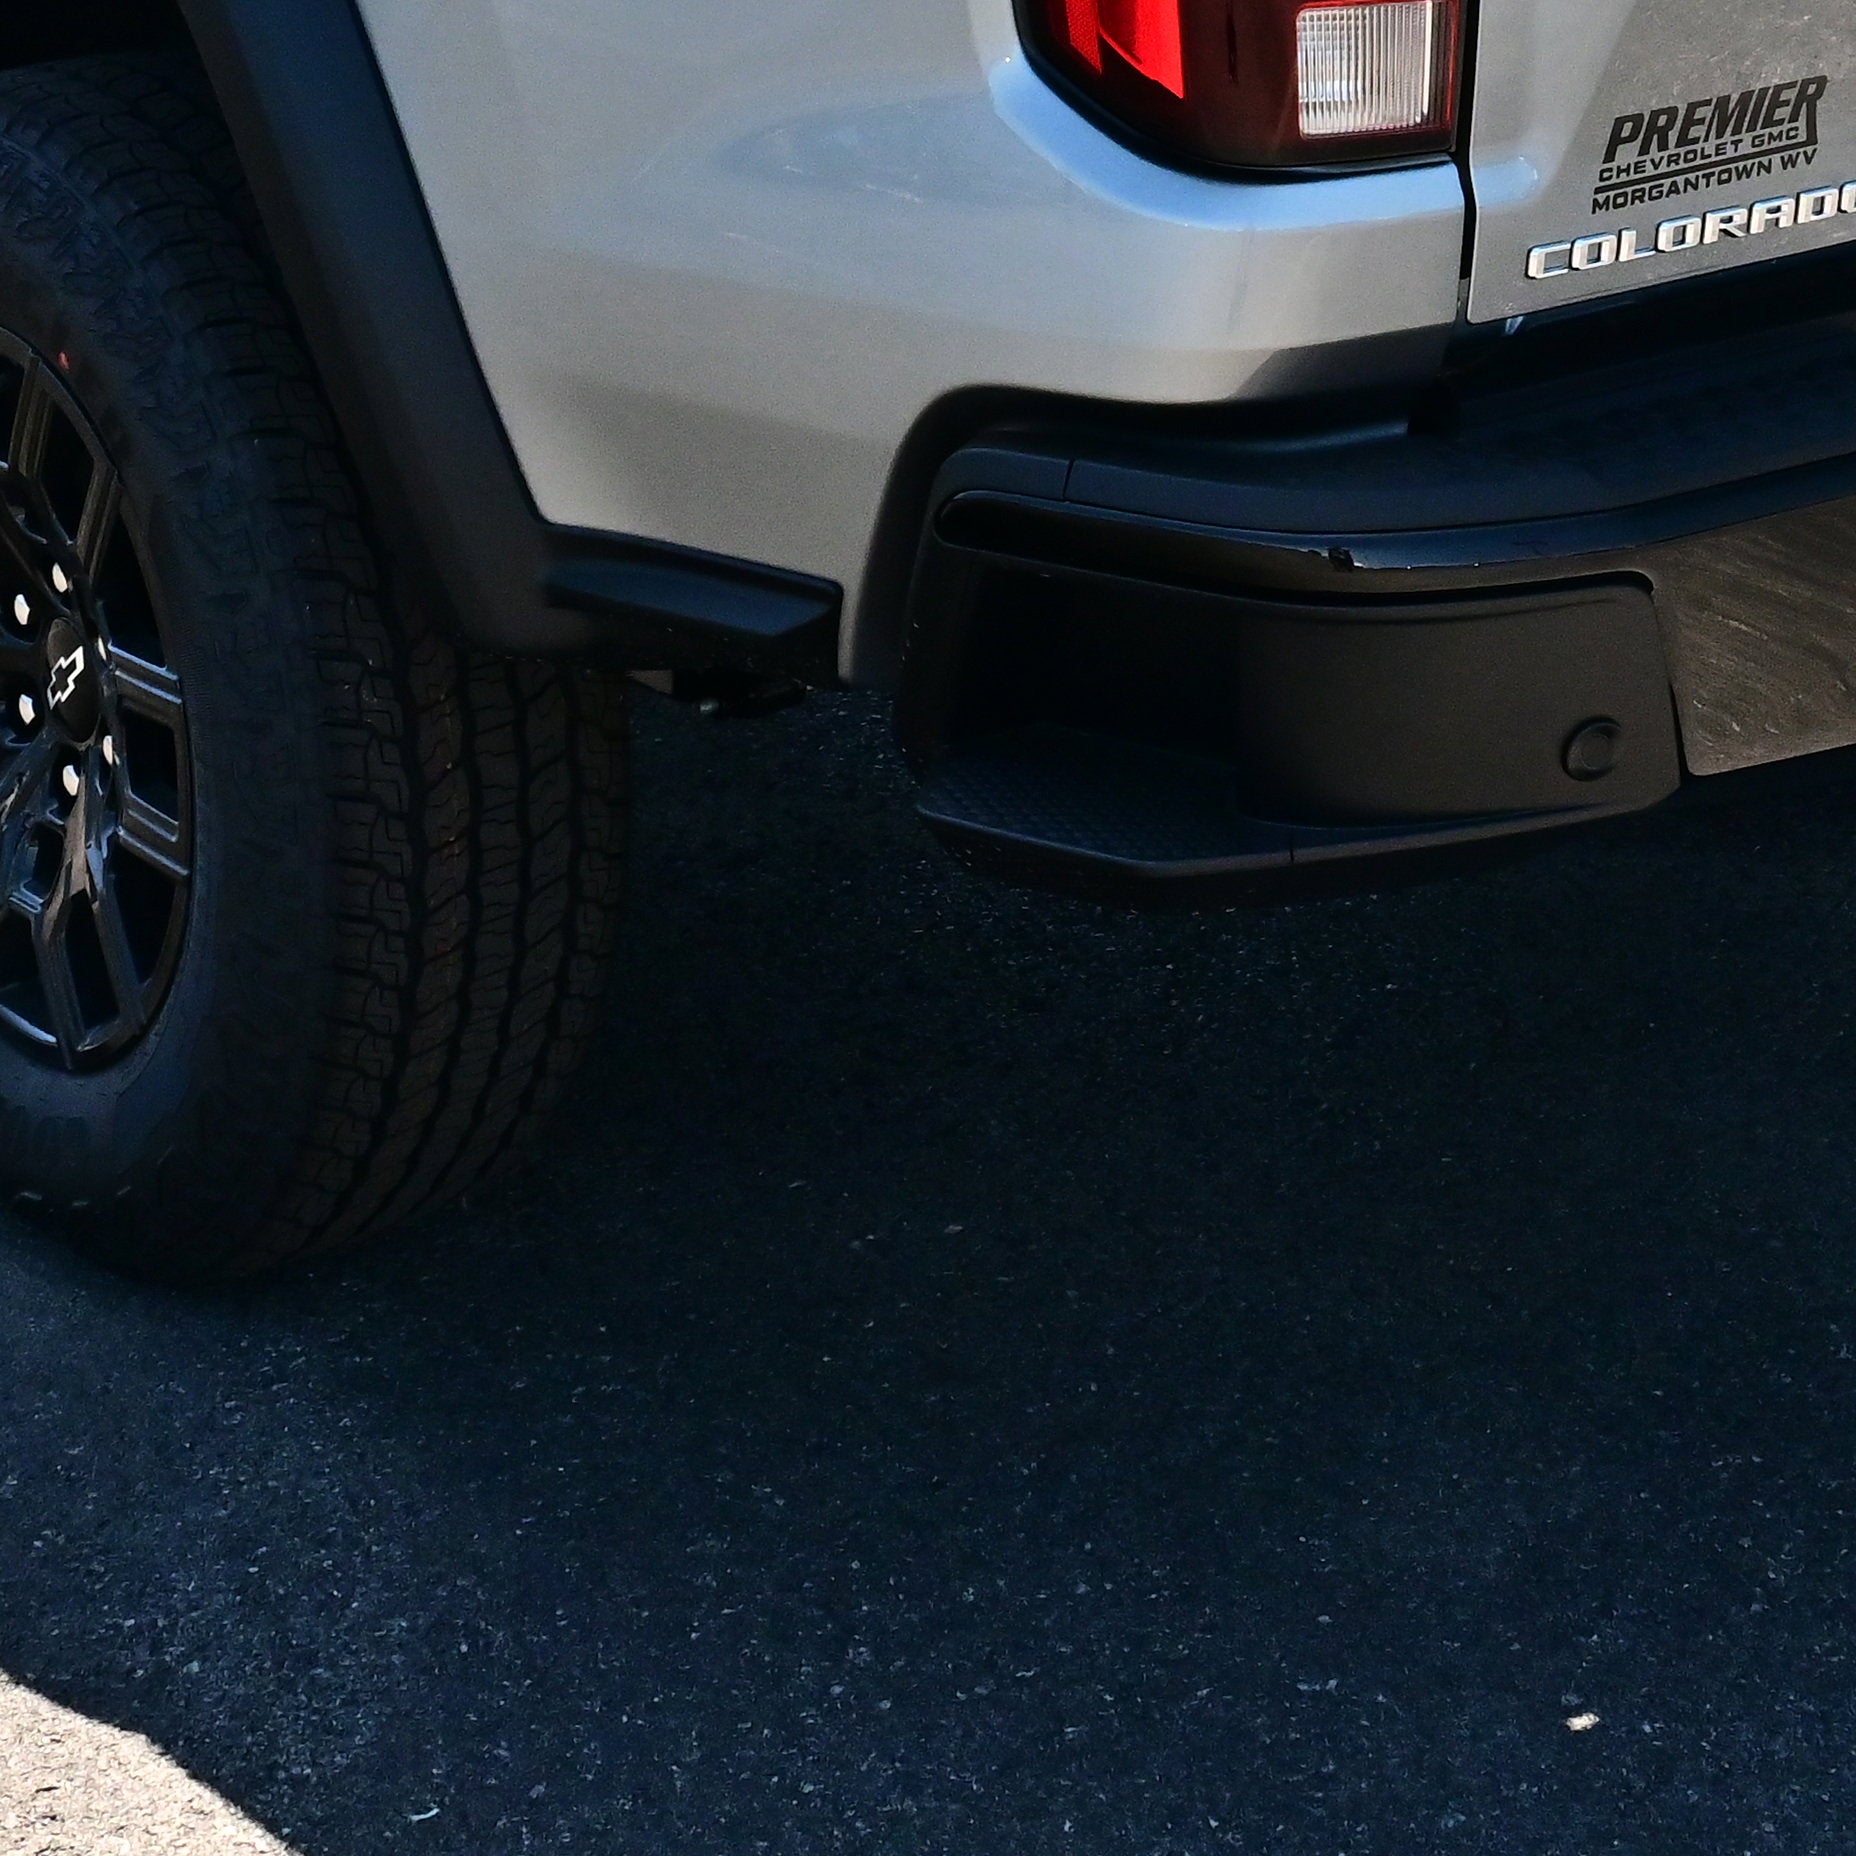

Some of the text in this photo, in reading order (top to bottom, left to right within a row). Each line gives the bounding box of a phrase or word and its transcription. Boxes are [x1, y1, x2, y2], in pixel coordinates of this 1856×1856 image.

[1599, 125, 1800, 183] CHEVROLET GMC
[1602, 75, 1828, 165] PREMIER
[1591, 147, 1818, 216] MORGANTOWN WV
